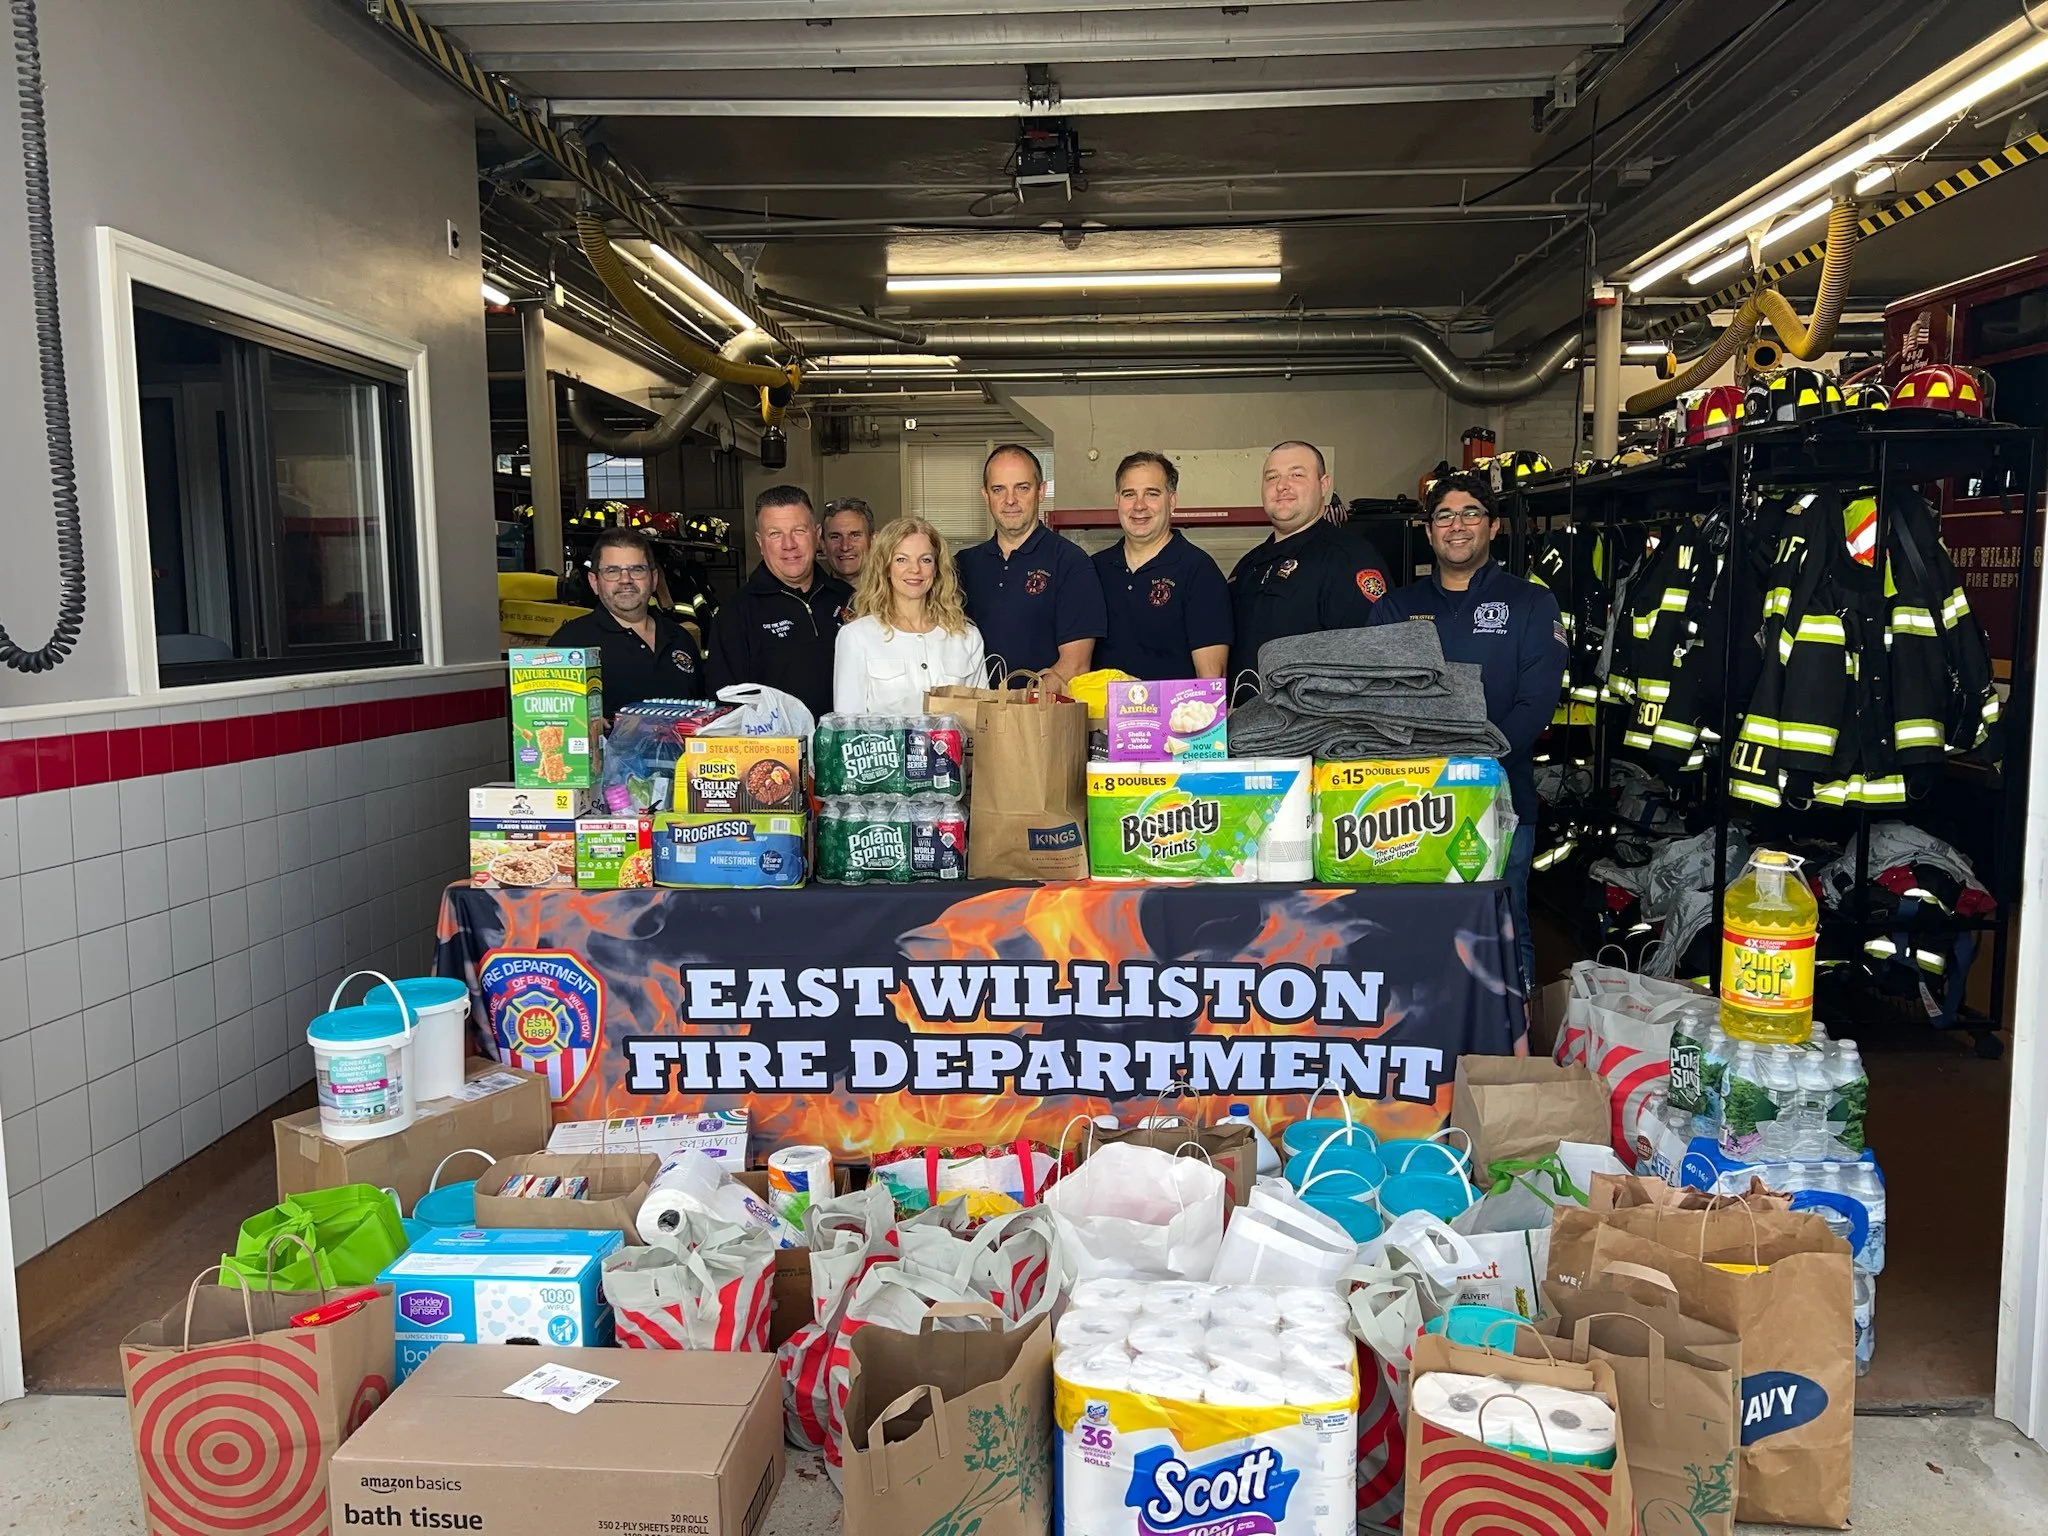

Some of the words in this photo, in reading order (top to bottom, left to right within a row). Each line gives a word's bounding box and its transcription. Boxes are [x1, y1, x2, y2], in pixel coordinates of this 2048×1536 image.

[1965, 573, 1989, 588] FIRE
[1486, 609, 1496, 619] 1
[514, 669, 549, 684] NATURE
[549, 669, 583, 682] VALLEY
[1210, 682, 1222, 691] 12
[1184, 690, 1207, 699] CHEESE!
[524, 696, 576, 714] CRUNCHY
[1119, 704, 1158, 714] Annie's
[710, 745, 742, 755] STEAKS,
[744, 746, 769, 754] CHOPS
[777, 746, 795, 754] RIBS
[841, 734, 897, 762] Poland
[700, 764, 736, 775] BUSH'S
[844, 752, 900, 778] Spring
[1365, 767, 1406, 776] DOUBLES
[1409, 766, 1430, 774] PLUS
[691, 778, 740, 791] GRILLIN'
[1118, 777, 1166, 786] DOUBLES
[701, 789, 736, 798] BEANS
[557, 796, 568, 806] 52
[509, 808, 534, 816] QUAKER
[674, 821, 748, 843] PROGRESSO
[1122, 799, 1219, 852] Bounty
[1335, 792, 1453, 860] Bounty
[848, 827, 903, 853] Poland
[1035, 830, 1076, 845] KINGS
[661, 847, 669, 856] 8
[850, 843, 905, 867] Spring
[1152, 838, 1196, 859] Prints
[1376, 850, 1388, 858] The
[1389, 841, 1417, 856] Quicker
[710, 856, 756, 865] MINESTRONE
[1374, 855, 1395, 865] Picker
[1396, 848, 1418, 860] Upper
[1744, 938, 1759, 948] 4X
[481, 967, 504, 992] FIRE
[502, 960, 595, 994] DEPARTMENT
[1743, 969, 1780, 995] Sol
[686, 967, 894, 1019] EAST
[908, 965, 1384, 1021] WILLISTON
[512, 976, 526, 988] OF
[526, 975, 552, 986] EAST
[569, 994, 591, 1038] WILLISTON
[526, 1018, 551, 1028] EST.
[525, 1028, 552, 1037] 1889
[339, 1059, 372, 1067] GENERAL
[629, 1040, 828, 1090] FIRE
[851, 1039, 1443, 1099] DEPARTMENT
[336, 1069, 381, 1078] DISINFECTING
[680, 1136, 738, 1148] DIAPERS
[748, 1200, 776, 1222] Scott
[541, 1288, 575, 1303] 1080
[410, 1296, 444, 1309] berkley
[410, 1306, 444, 1317] jensen
[1081, 1424, 1113, 1449] 36
[1079, 1445, 1116, 1456] INDIVIDUALLY
[1084, 1451, 1112, 1461] WRAPPED
[1084, 1457, 1110, 1468] ROLLS
[361, 1476, 414, 1489] amazon
[416, 1475, 462, 1491] basics
[1147, 1449, 1276, 1525] Scott
[1269, 1481, 1285, 1491] Brand
[345, 1503, 402, 1526] bath
[409, 1506, 483, 1531] tissue
[670, 1513, 682, 1523] 30
[682, 1514, 709, 1524] ROLLS
[598, 1520, 613, 1529] 350
[614, 1521, 638, 1531] 2-PLY
[638, 1522, 669, 1533] SHEETS
[670, 1524, 686, 1533] PER
[687, 1525, 709, 1535] ROLL
